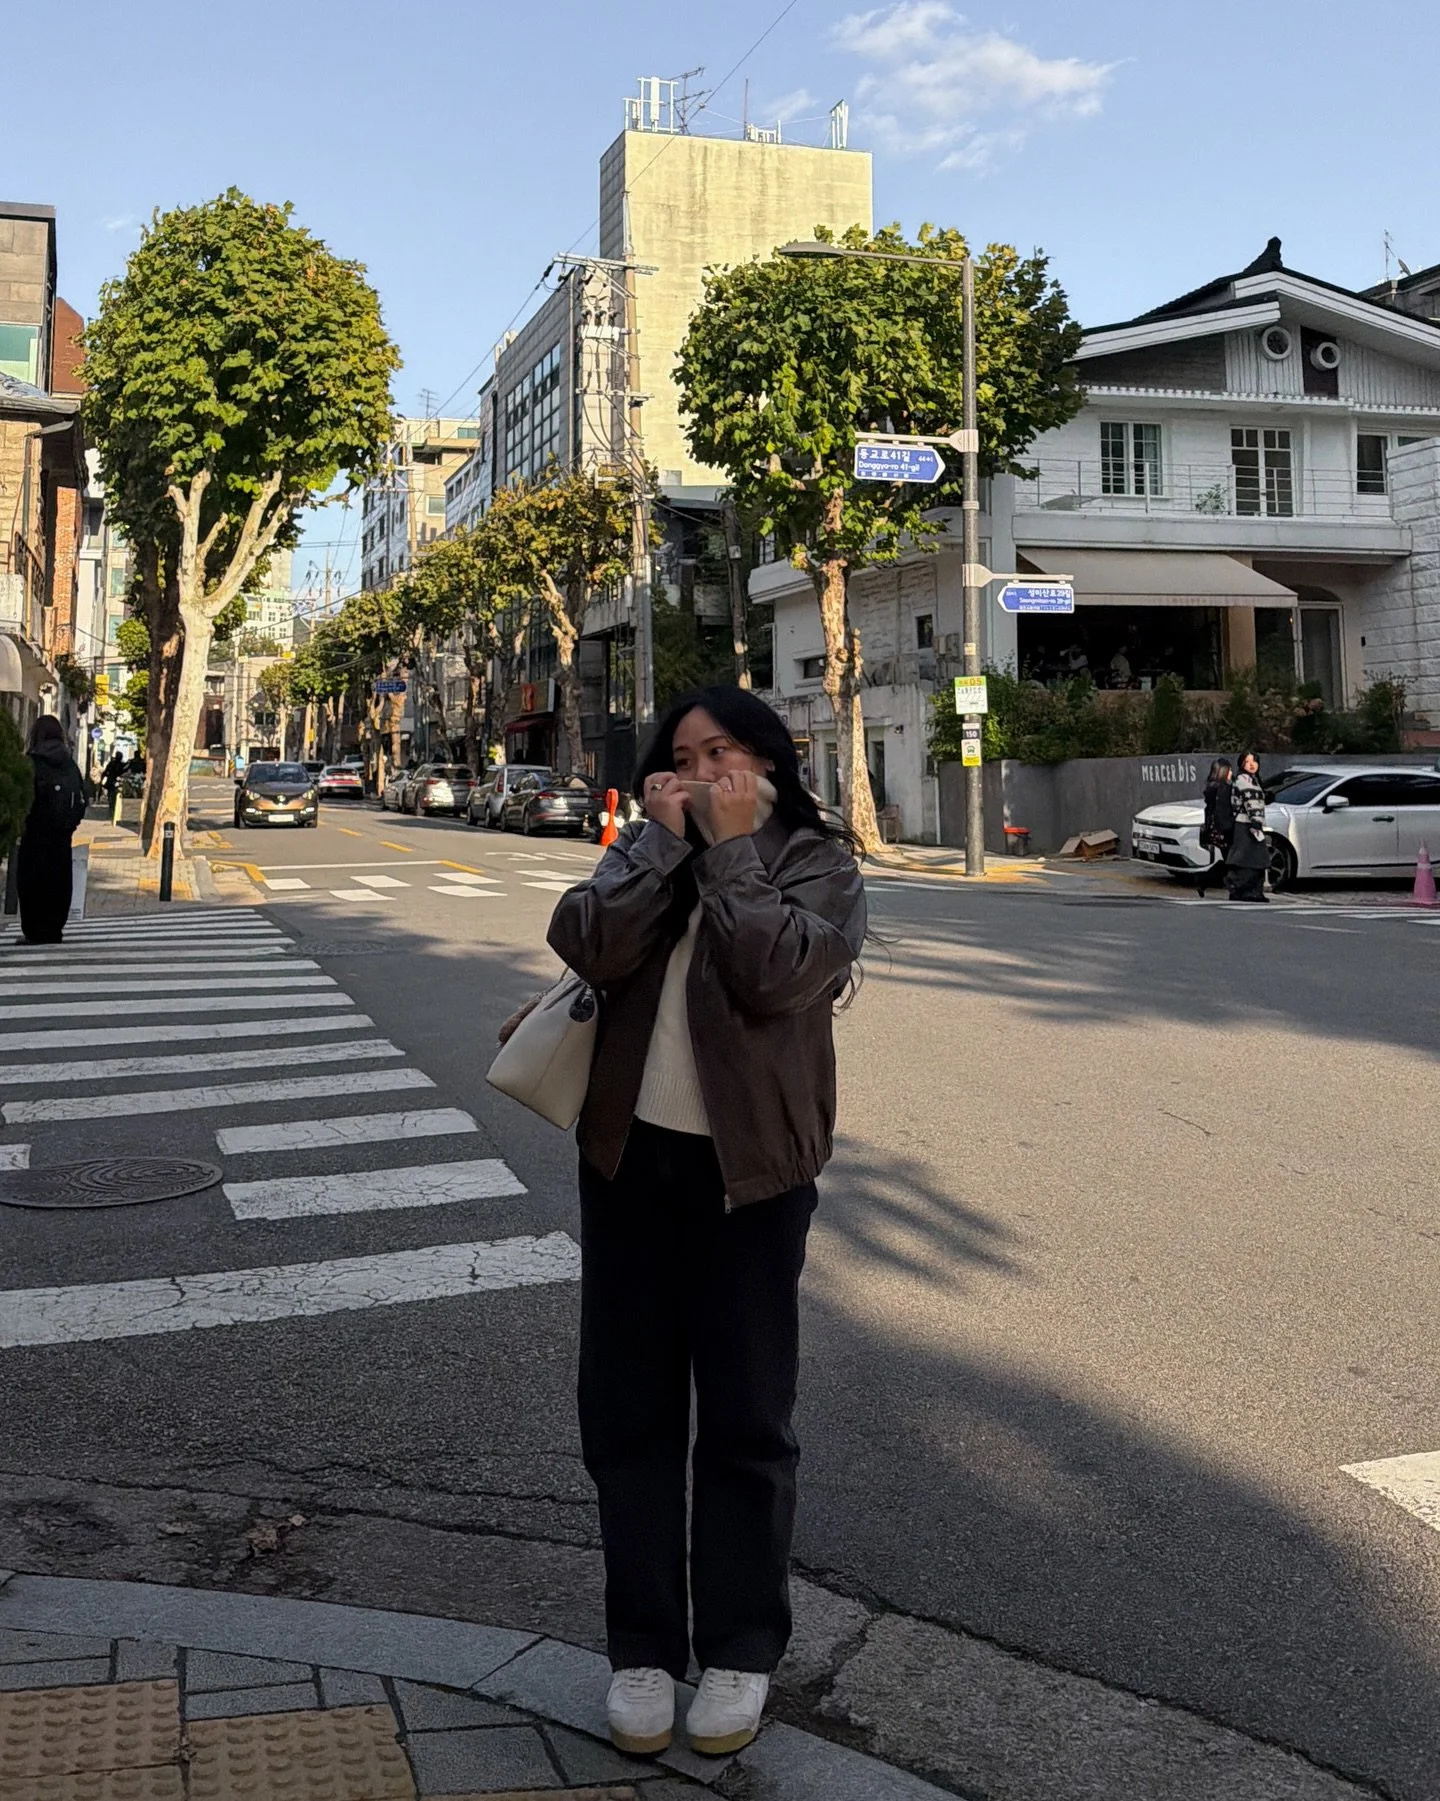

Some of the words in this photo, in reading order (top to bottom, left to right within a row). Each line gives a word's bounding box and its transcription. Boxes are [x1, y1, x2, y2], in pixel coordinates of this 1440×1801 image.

[859, 448, 910, 462] 동교로41길
[858, 461, 899, 470] Donggyo-ro
[965, 730, 978, 738] 150
[1141, 764, 1176, 782] MERCER
[1178, 758, 1197, 783] bis
